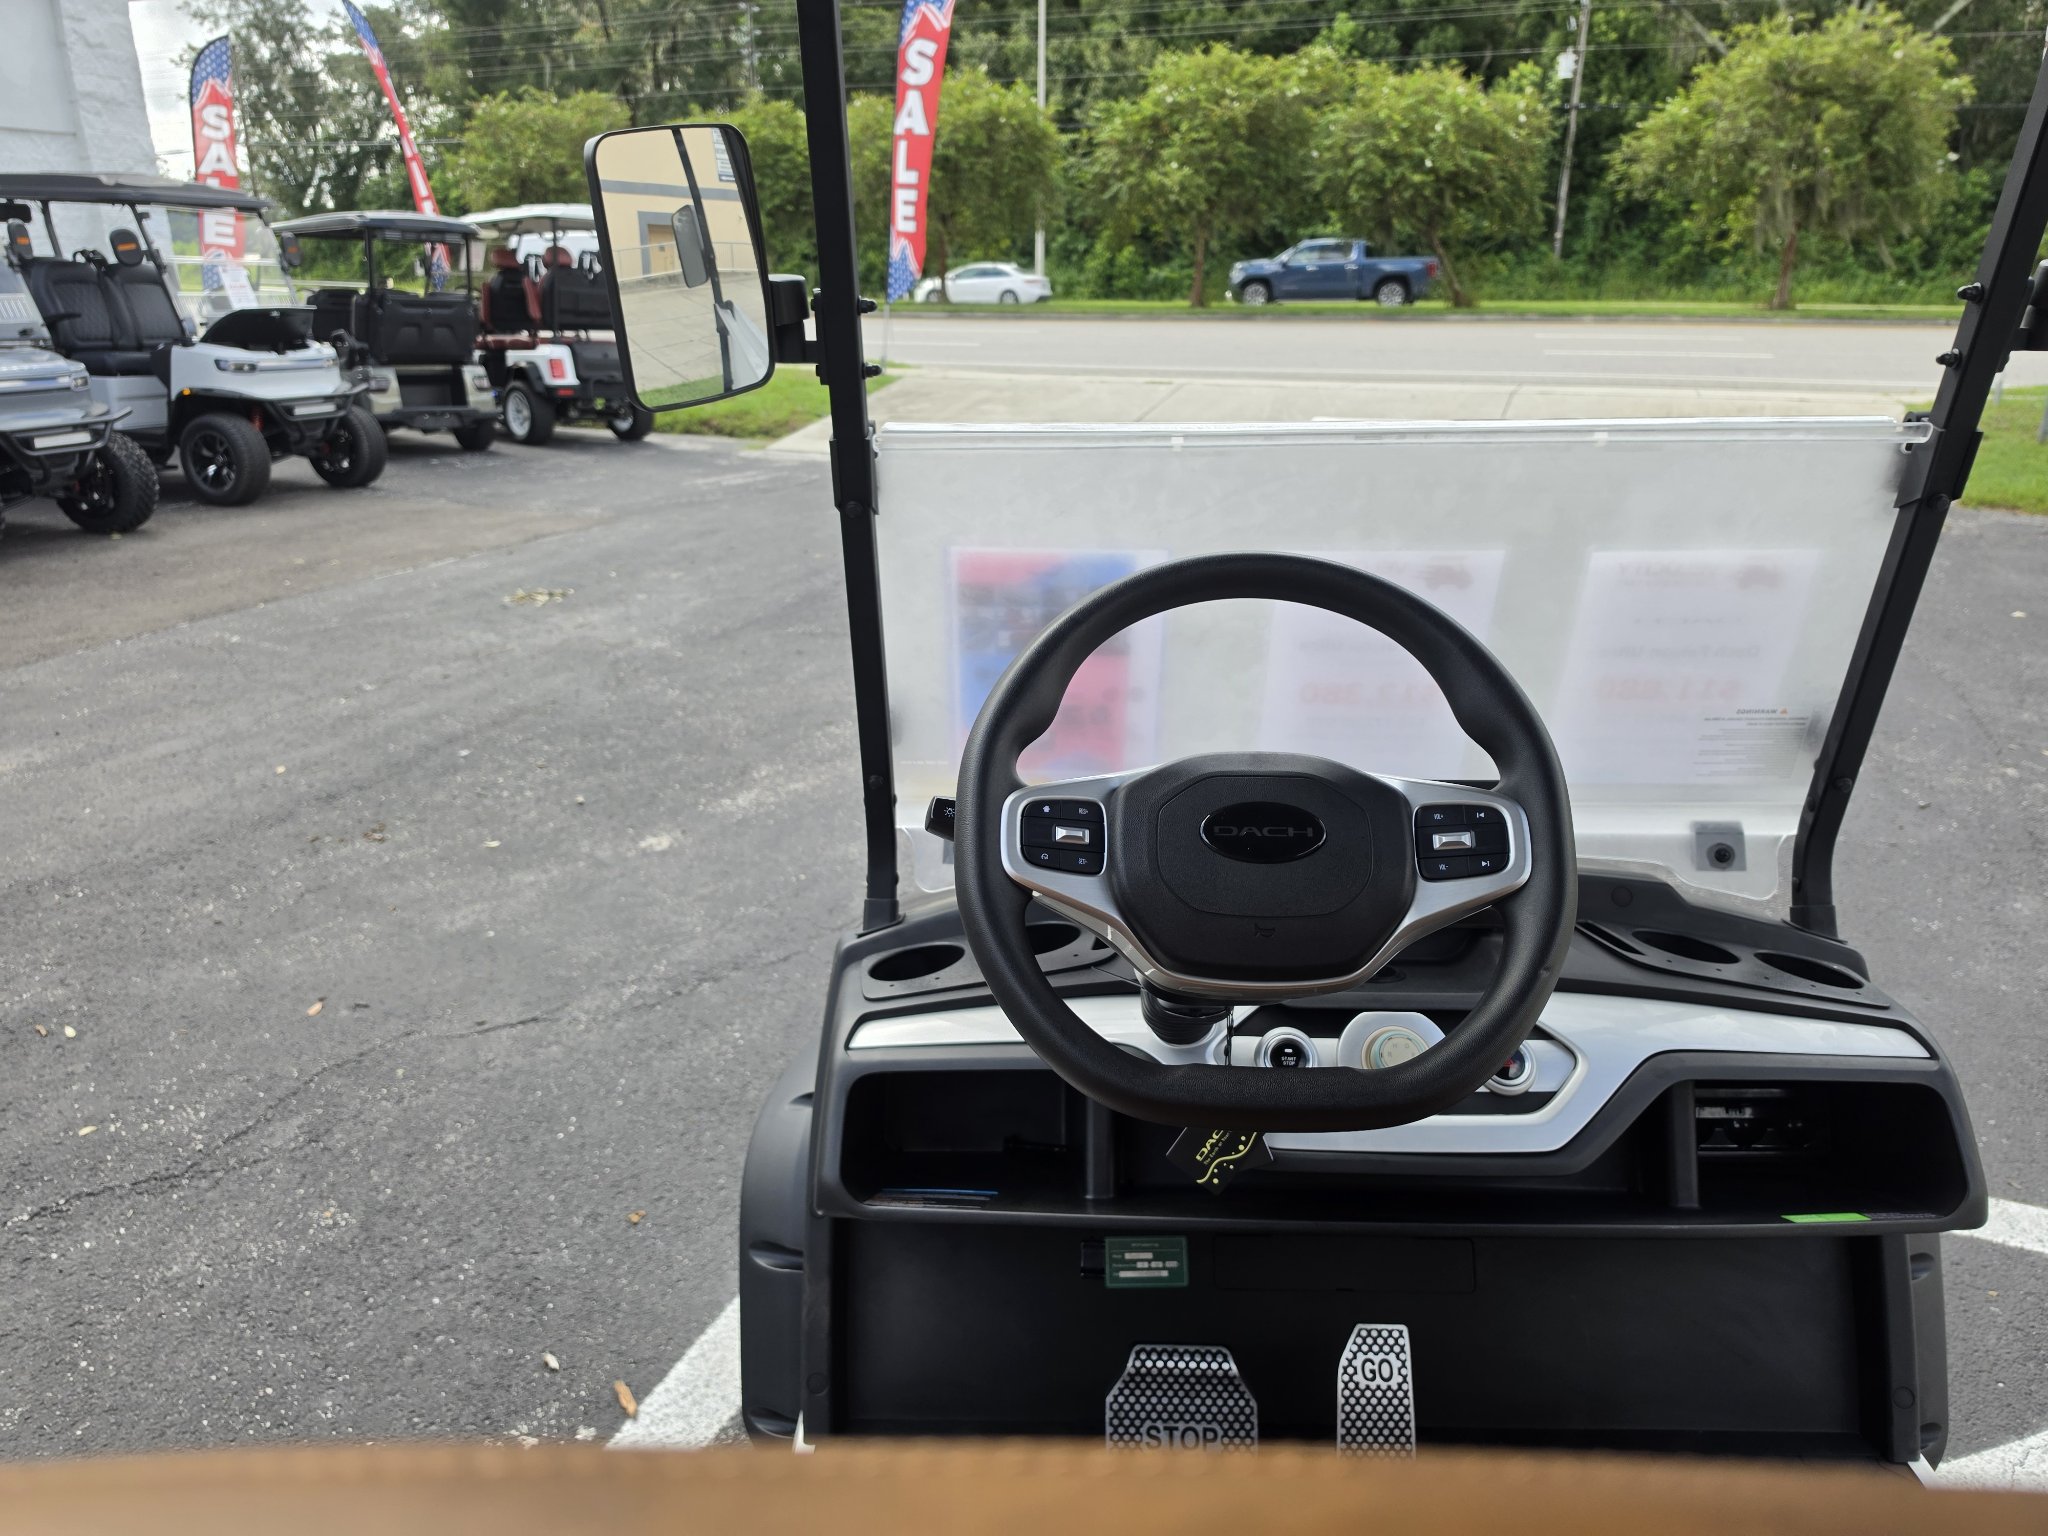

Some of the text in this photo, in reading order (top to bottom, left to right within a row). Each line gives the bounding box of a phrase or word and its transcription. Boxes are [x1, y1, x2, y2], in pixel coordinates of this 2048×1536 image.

[894, 38, 938, 233] SALE
[1213, 825, 1313, 837] DACH
[1361, 1358, 1394, 1382] GO
[1145, 1425, 1219, 1450] STOP
